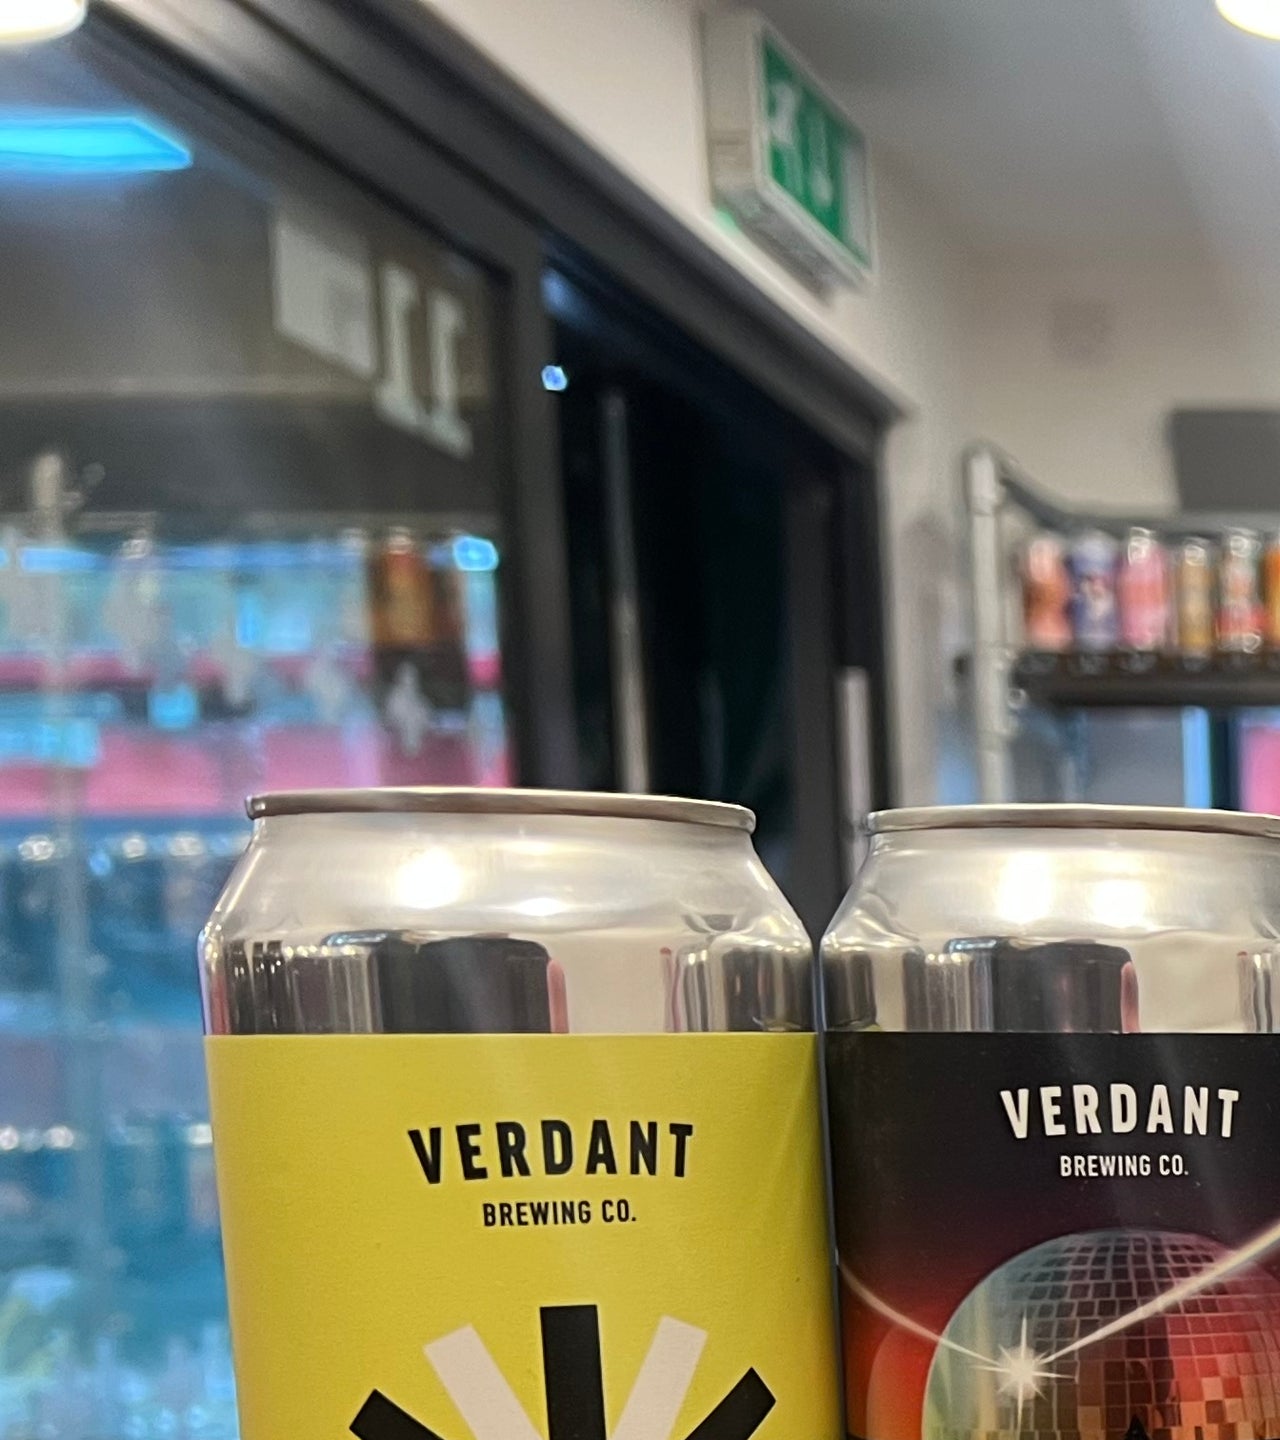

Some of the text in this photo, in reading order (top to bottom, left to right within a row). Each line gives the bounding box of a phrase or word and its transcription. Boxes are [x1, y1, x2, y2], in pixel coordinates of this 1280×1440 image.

[1000, 1083, 1241, 1139] VERDANT
[408, 1119, 694, 1186] VERDANT
[1059, 1153, 1189, 1177] BREWING CO.
[482, 1197, 637, 1229] BREWING CO.
